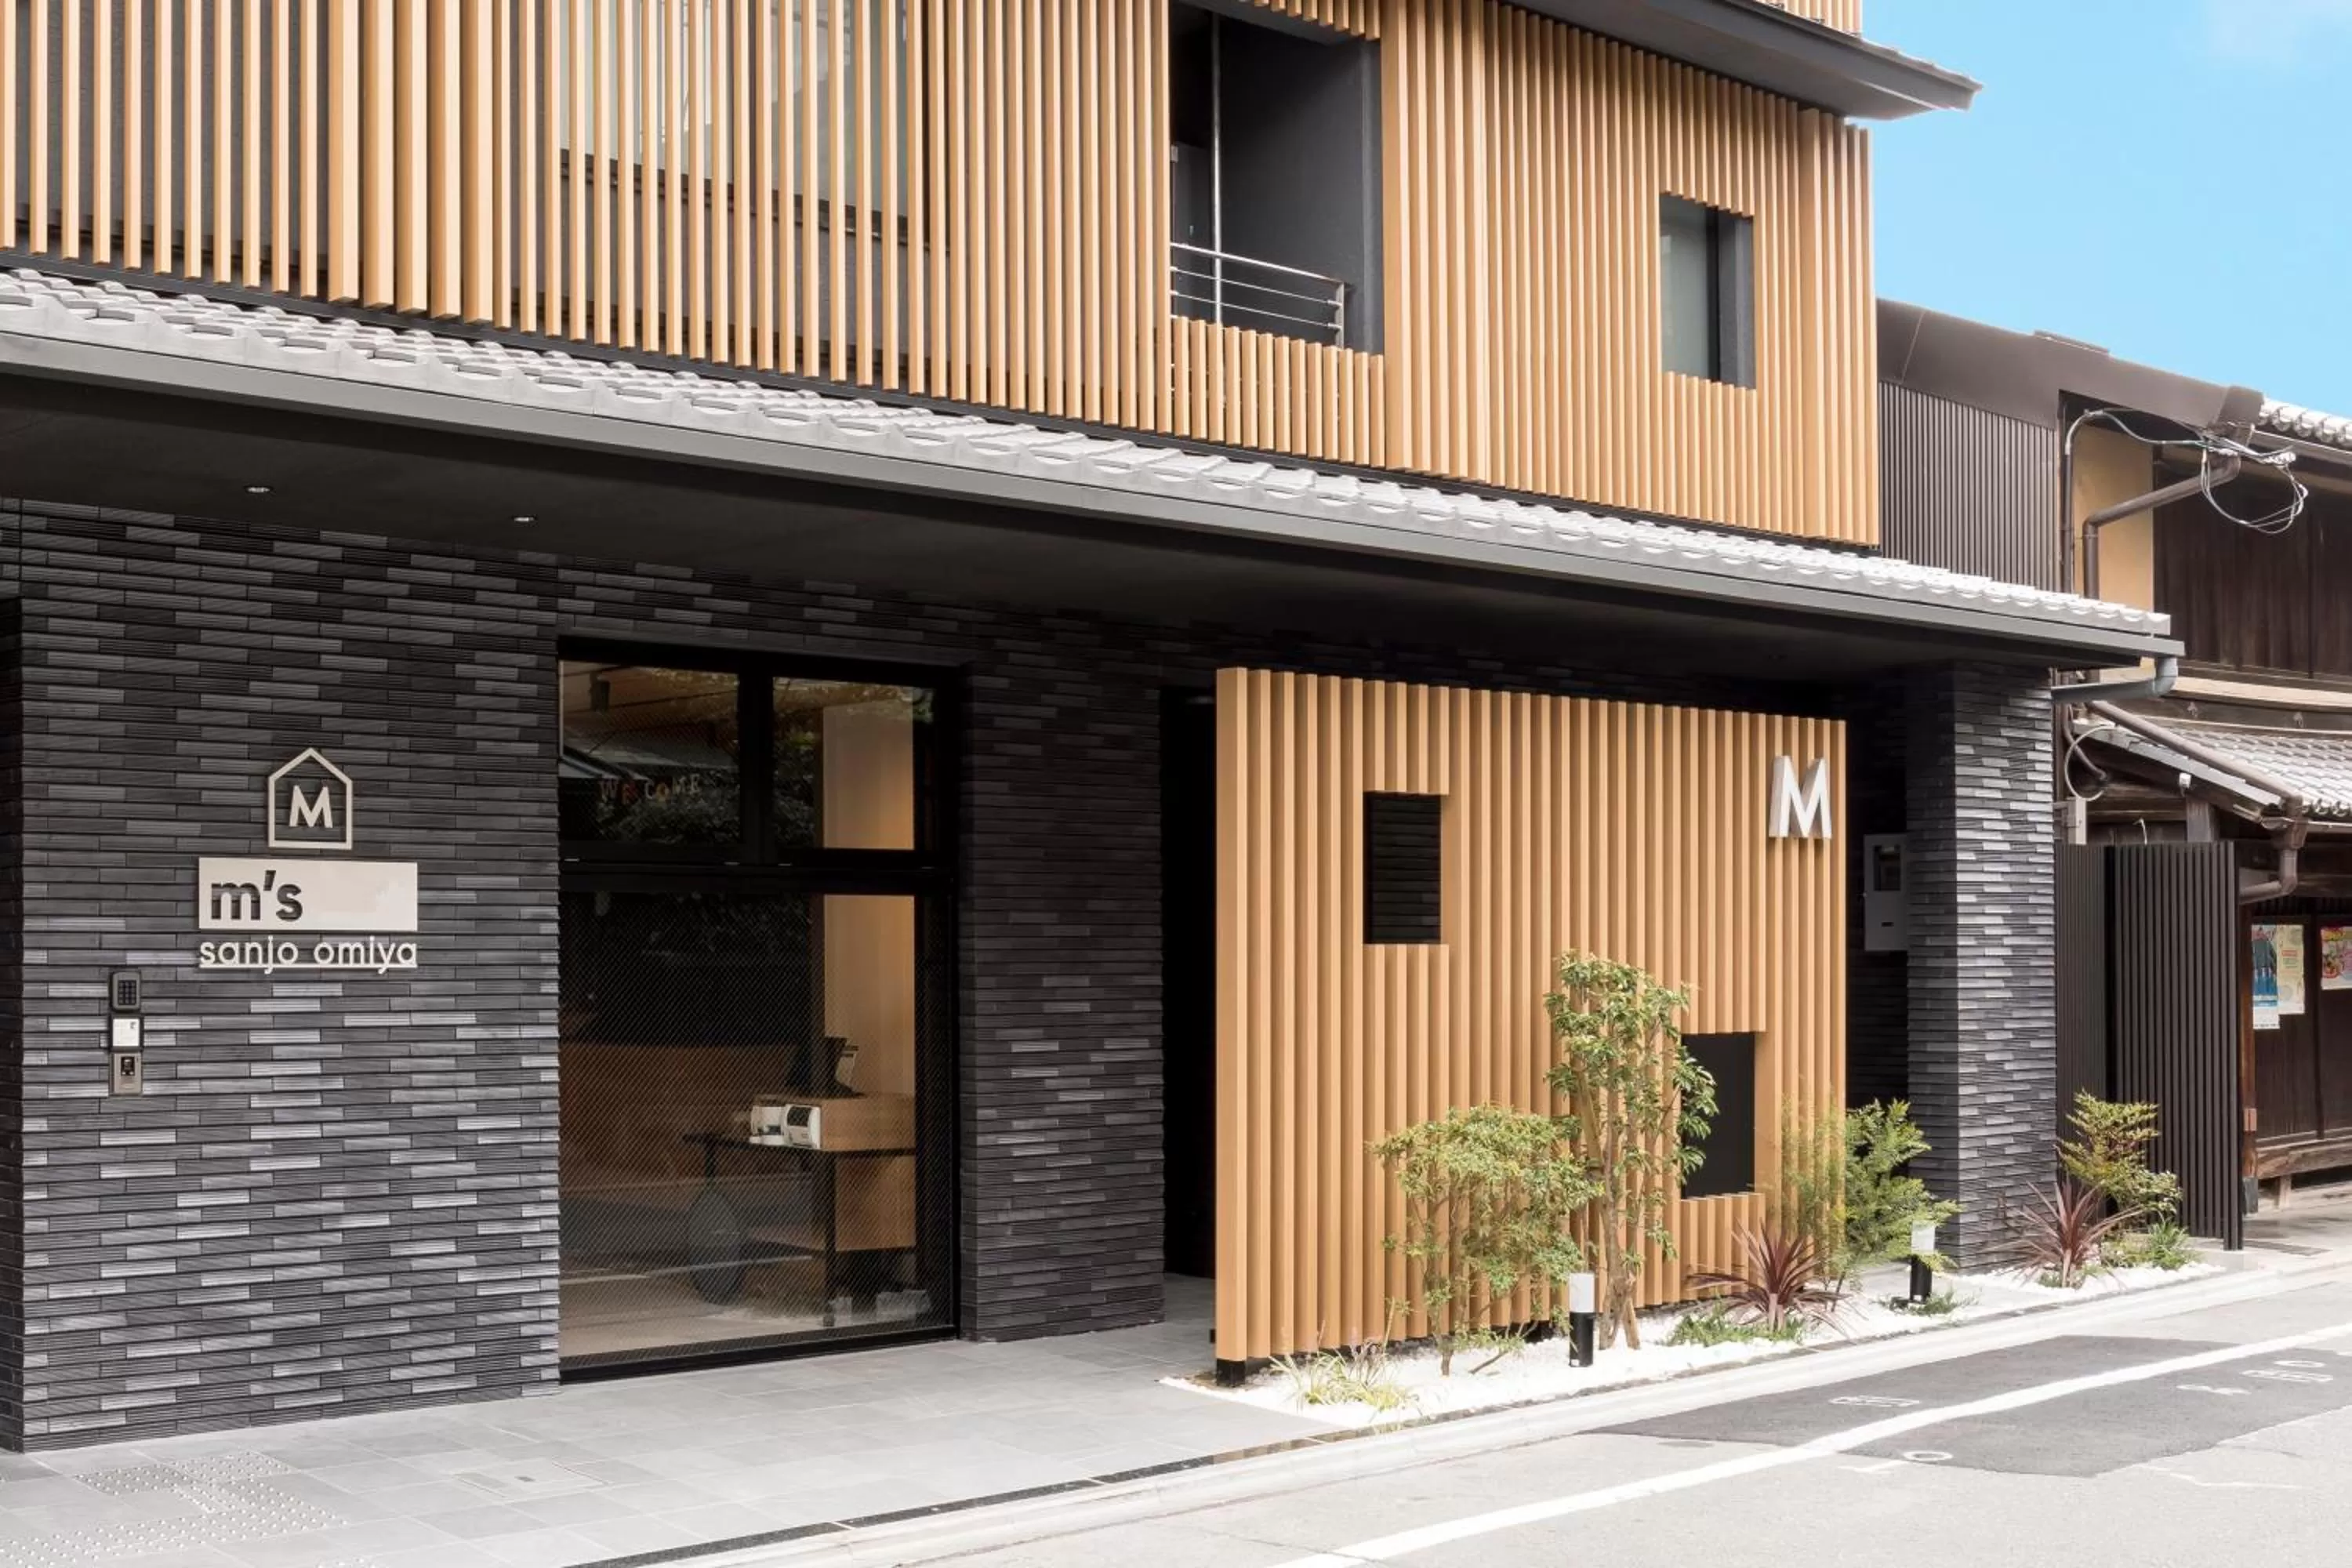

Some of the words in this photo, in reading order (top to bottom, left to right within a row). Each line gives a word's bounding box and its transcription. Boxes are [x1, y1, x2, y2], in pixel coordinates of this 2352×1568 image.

[289, 785, 334, 829] M
[1768, 755, 1832, 840] M
[211, 869, 303, 921] m's
[199, 935, 299, 975] sanjo
[313, 935, 418, 975] omiya
